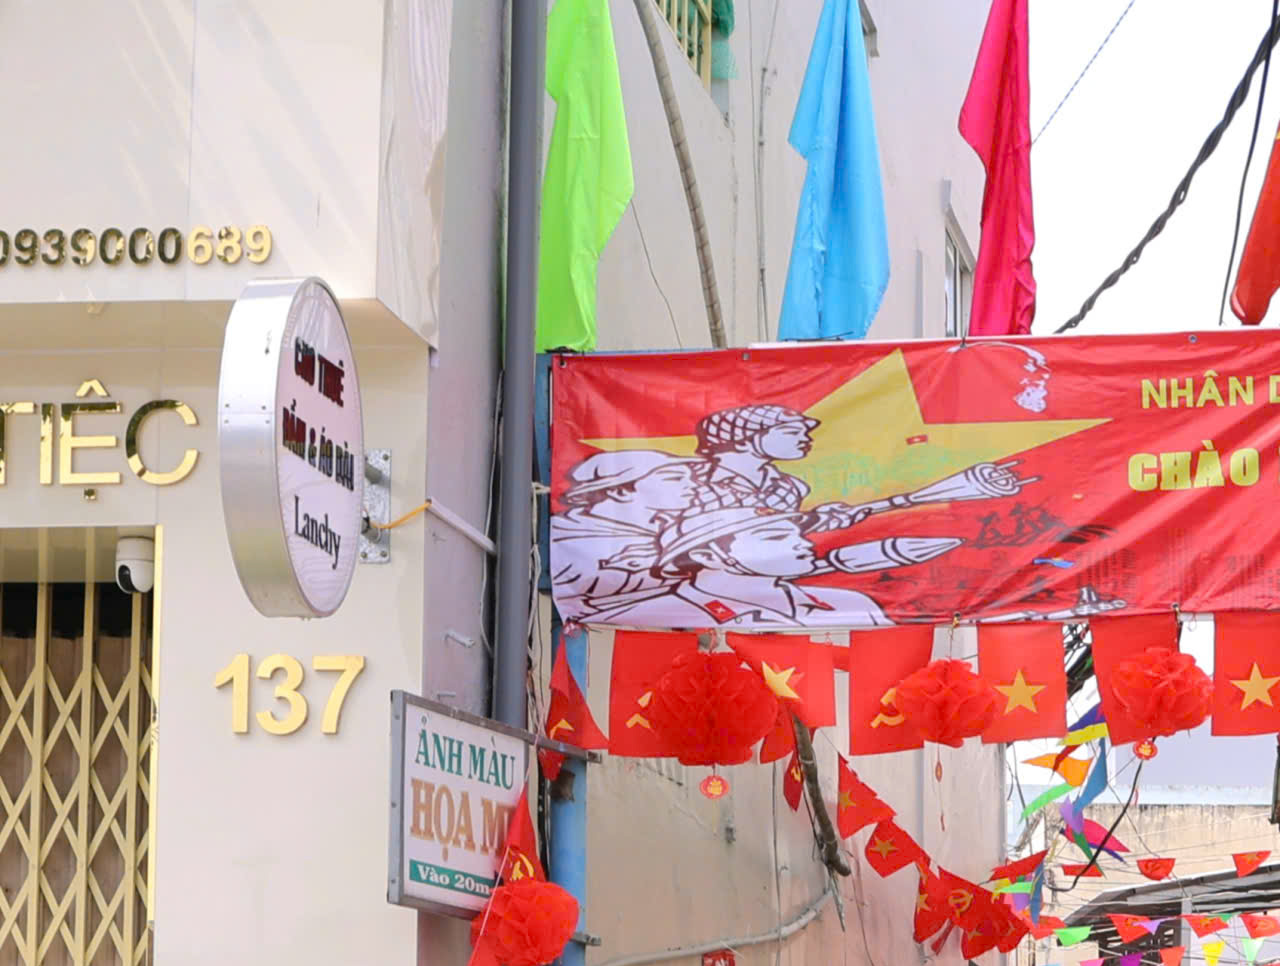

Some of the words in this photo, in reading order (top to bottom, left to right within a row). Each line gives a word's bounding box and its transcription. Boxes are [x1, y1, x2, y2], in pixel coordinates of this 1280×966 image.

[1141, 369, 1255, 409] NHÂN
[1127, 440, 1260, 491] CHÀO
[294, 496, 341, 570] Lanchy
[213, 653, 366, 736] 137
[415, 716, 463, 777] ẢNH
[468, 736, 516, 791] MÀU
[410, 778, 477, 863] HỌA
[416, 864, 450, 887] Vào
[453, 873, 491, 897] 20m
